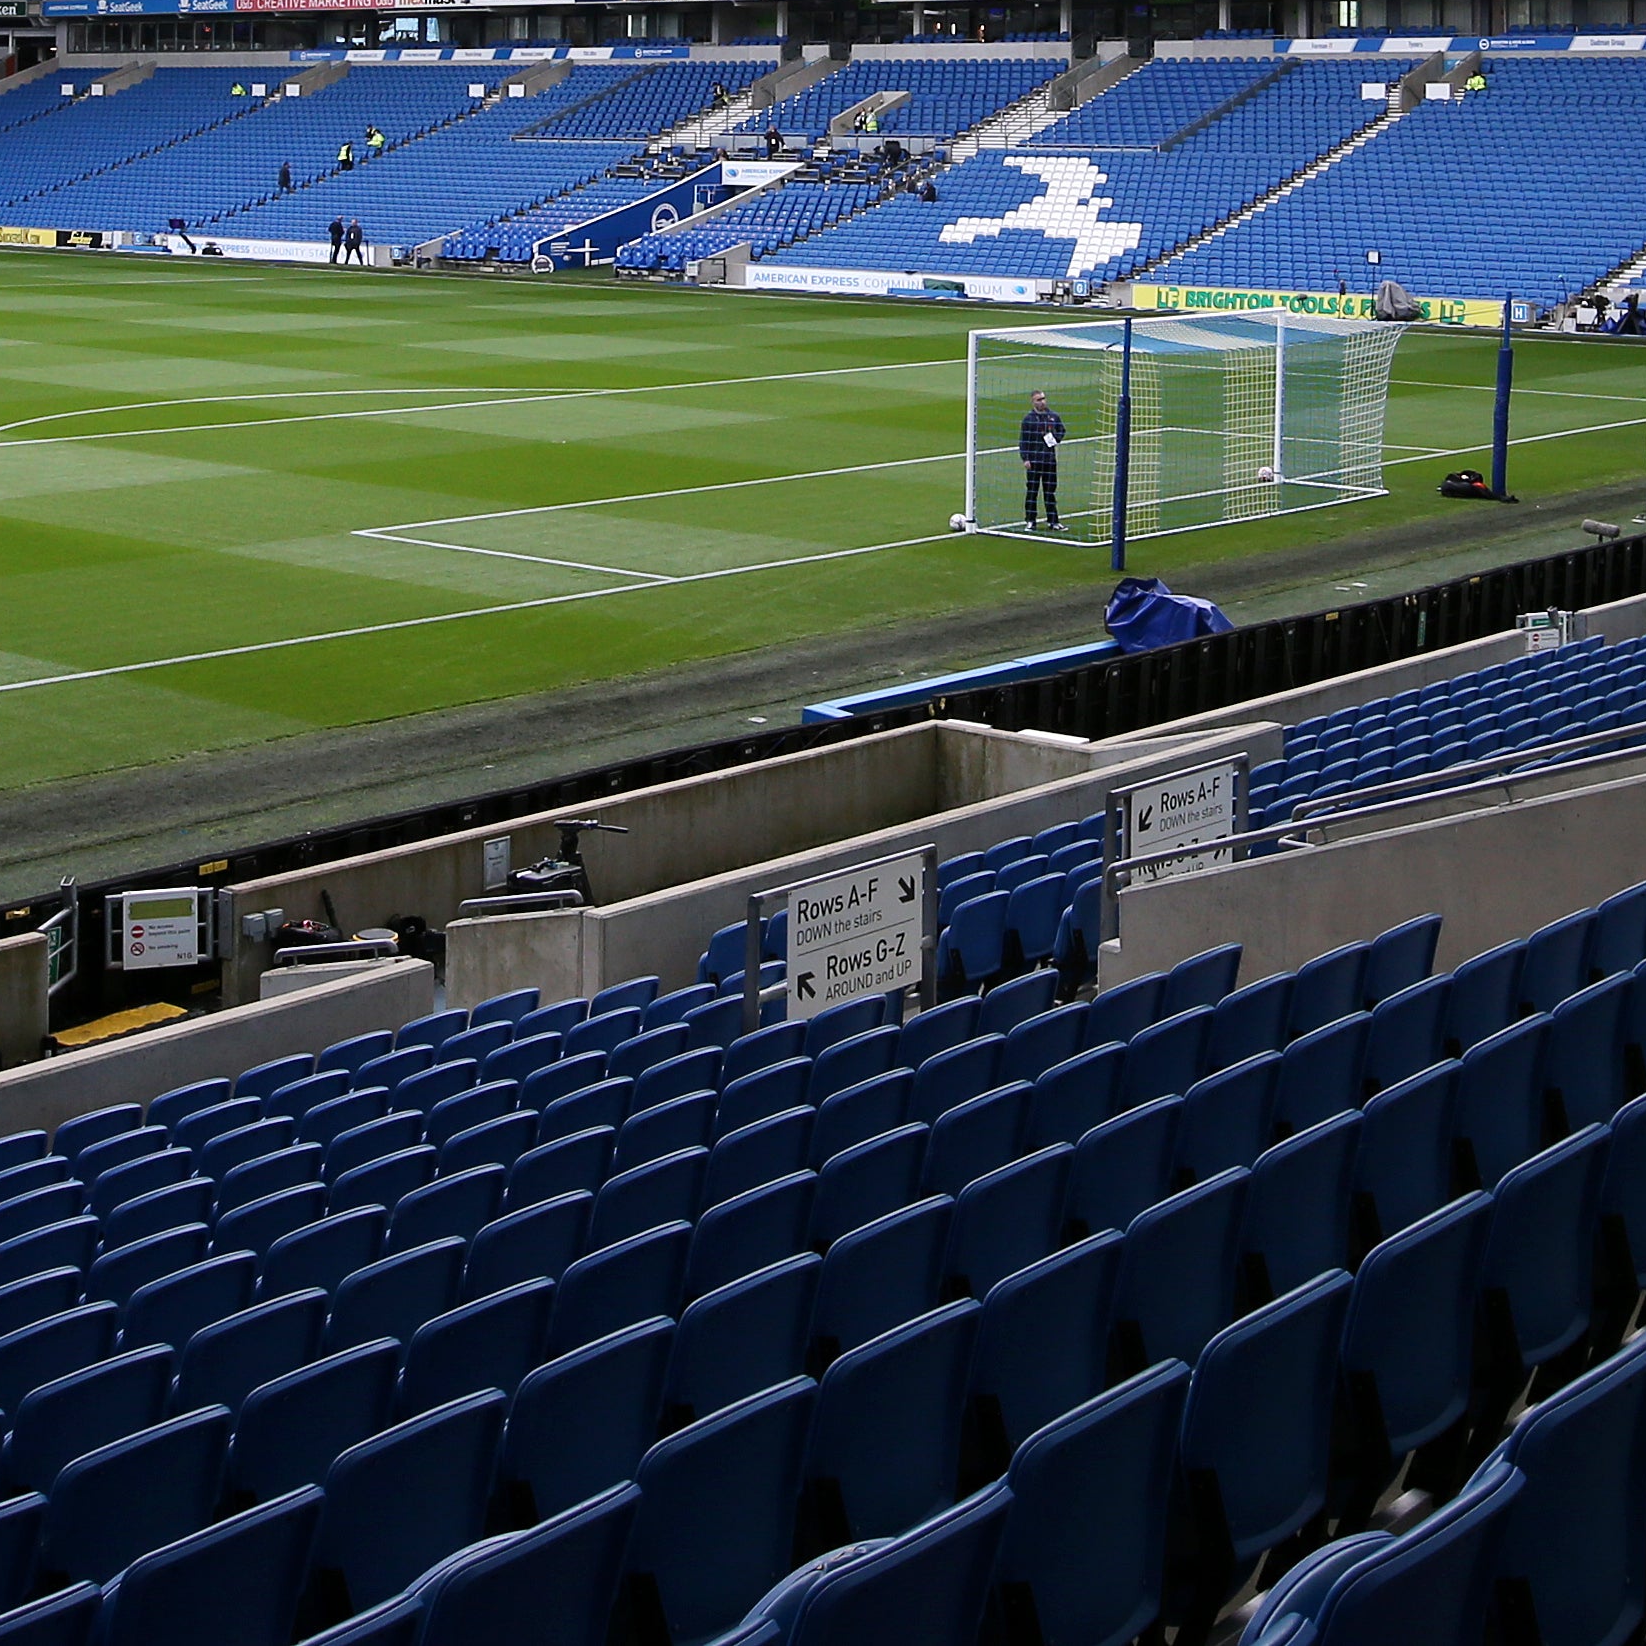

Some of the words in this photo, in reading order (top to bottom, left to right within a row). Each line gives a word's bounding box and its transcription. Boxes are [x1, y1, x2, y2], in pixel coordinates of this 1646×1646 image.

[109, 0, 144, 13] SeatGeek
[192, 0, 228, 11] SeatGeek
[221, 242, 250, 253] XPRESS
[252, 245, 307, 257] COMMUNITY
[753, 272, 808, 285] AMERICAN
[811, 274, 860, 287] EXPRESS
[864, 276, 923, 291] COMMUN
[1185, 290, 1275, 310] BRIGHTON
[1281, 293, 1340, 315] TOOLS
[1343, 298, 1355, 316] &
[1515, 305, 1524, 320] H
[1161, 788, 1195, 814] Rows
[1197, 776, 1221, 803] A-F
[1159, 812, 1186, 833] DOWN
[1187, 810, 1201, 826] the
[1201, 803, 1223, 820] stairs
[797, 894, 844, 925] Rows
[847, 878, 880, 912] A-F
[796, 923, 834, 947] DOWN
[835, 916, 853, 937] the
[854, 907, 883, 932] stairs
[826, 949, 874, 981] Rows
[877, 932, 907, 965] G-Z
[825, 972, 873, 1003] AROUND
[875, 966, 895, 989] and
[895, 958, 913, 982] UP
